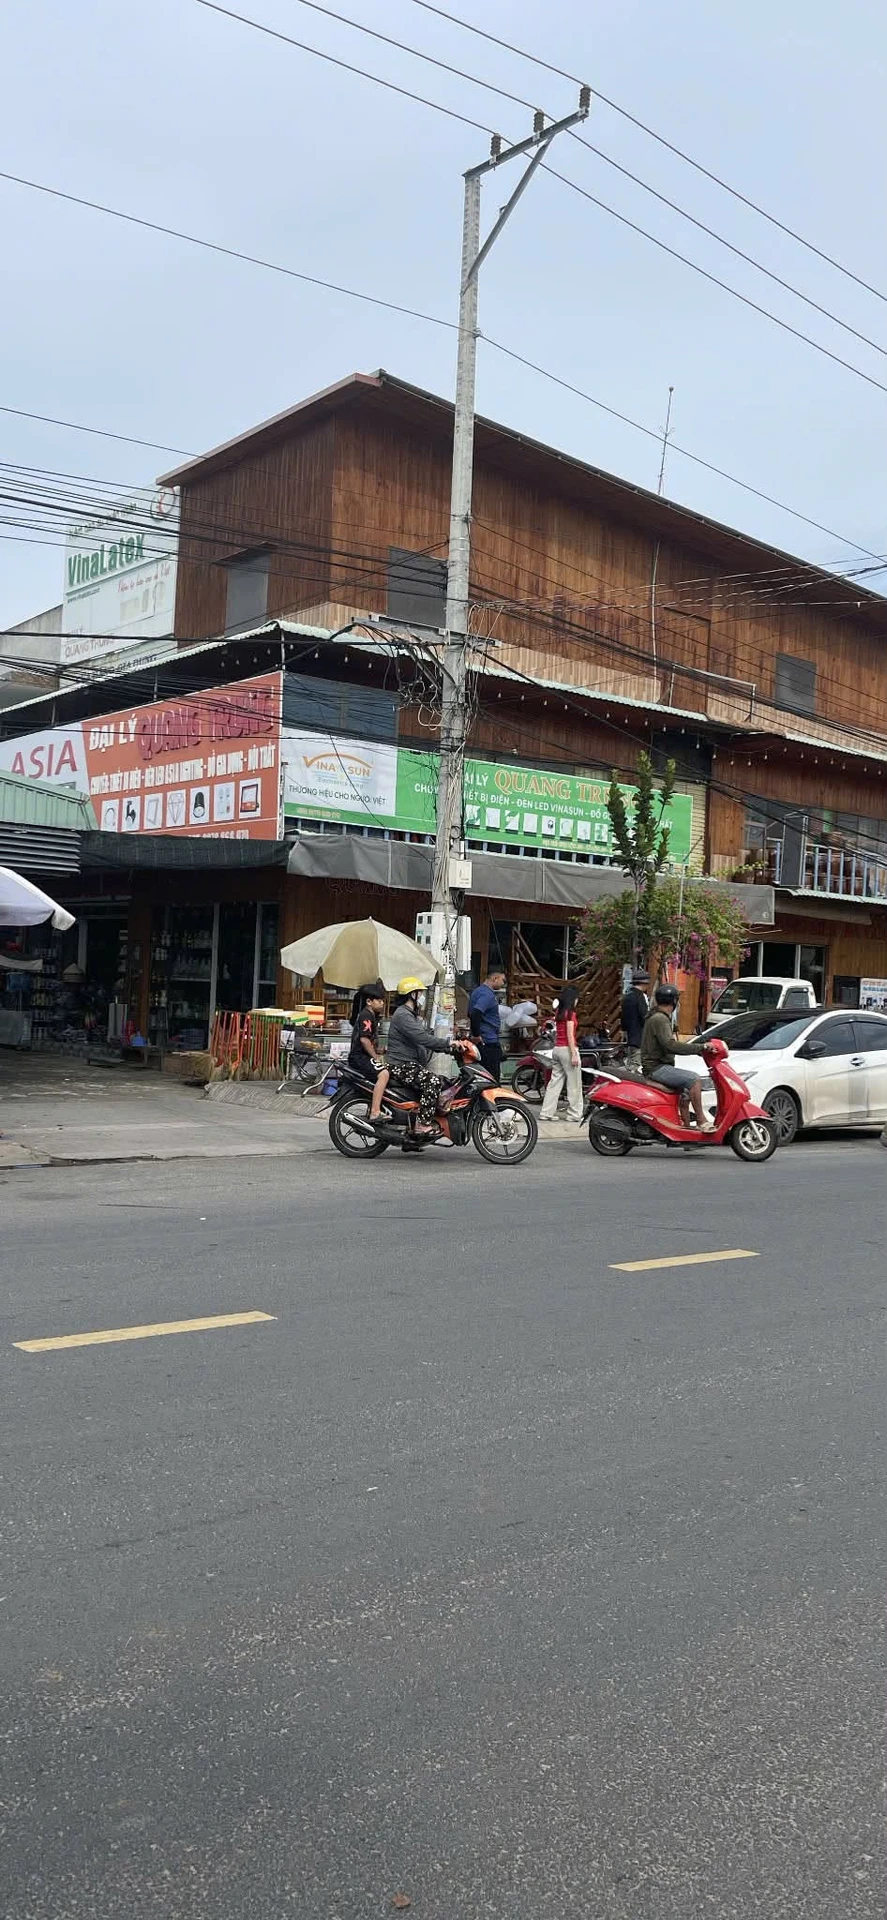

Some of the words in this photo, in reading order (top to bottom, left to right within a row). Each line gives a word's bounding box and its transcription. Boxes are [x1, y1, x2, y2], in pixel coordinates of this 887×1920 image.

[68, 533, 144, 587] VinaLatex
[89, 723, 115, 754] ĐẠI
[118, 713, 138, 745] LÝ
[139, 705, 202, 761] QUANG
[11, 739, 78, 779] ASIA
[348, 766, 370, 777] SUN
[289, 785, 317, 796] THƯƠNG
[319, 789, 333, 798] HIỆU
[334, 791, 349, 800] CHO
[476, 773, 489, 787] LÝ
[494, 769, 572, 801] QUANG
[480, 793, 489, 804] BỊ
[490, 794, 510, 806] ĐIỆN
[516, 796, 533, 809] ĐÈN
[534, 801, 549, 812] LED
[550, 803, 585, 817] VINASUN
